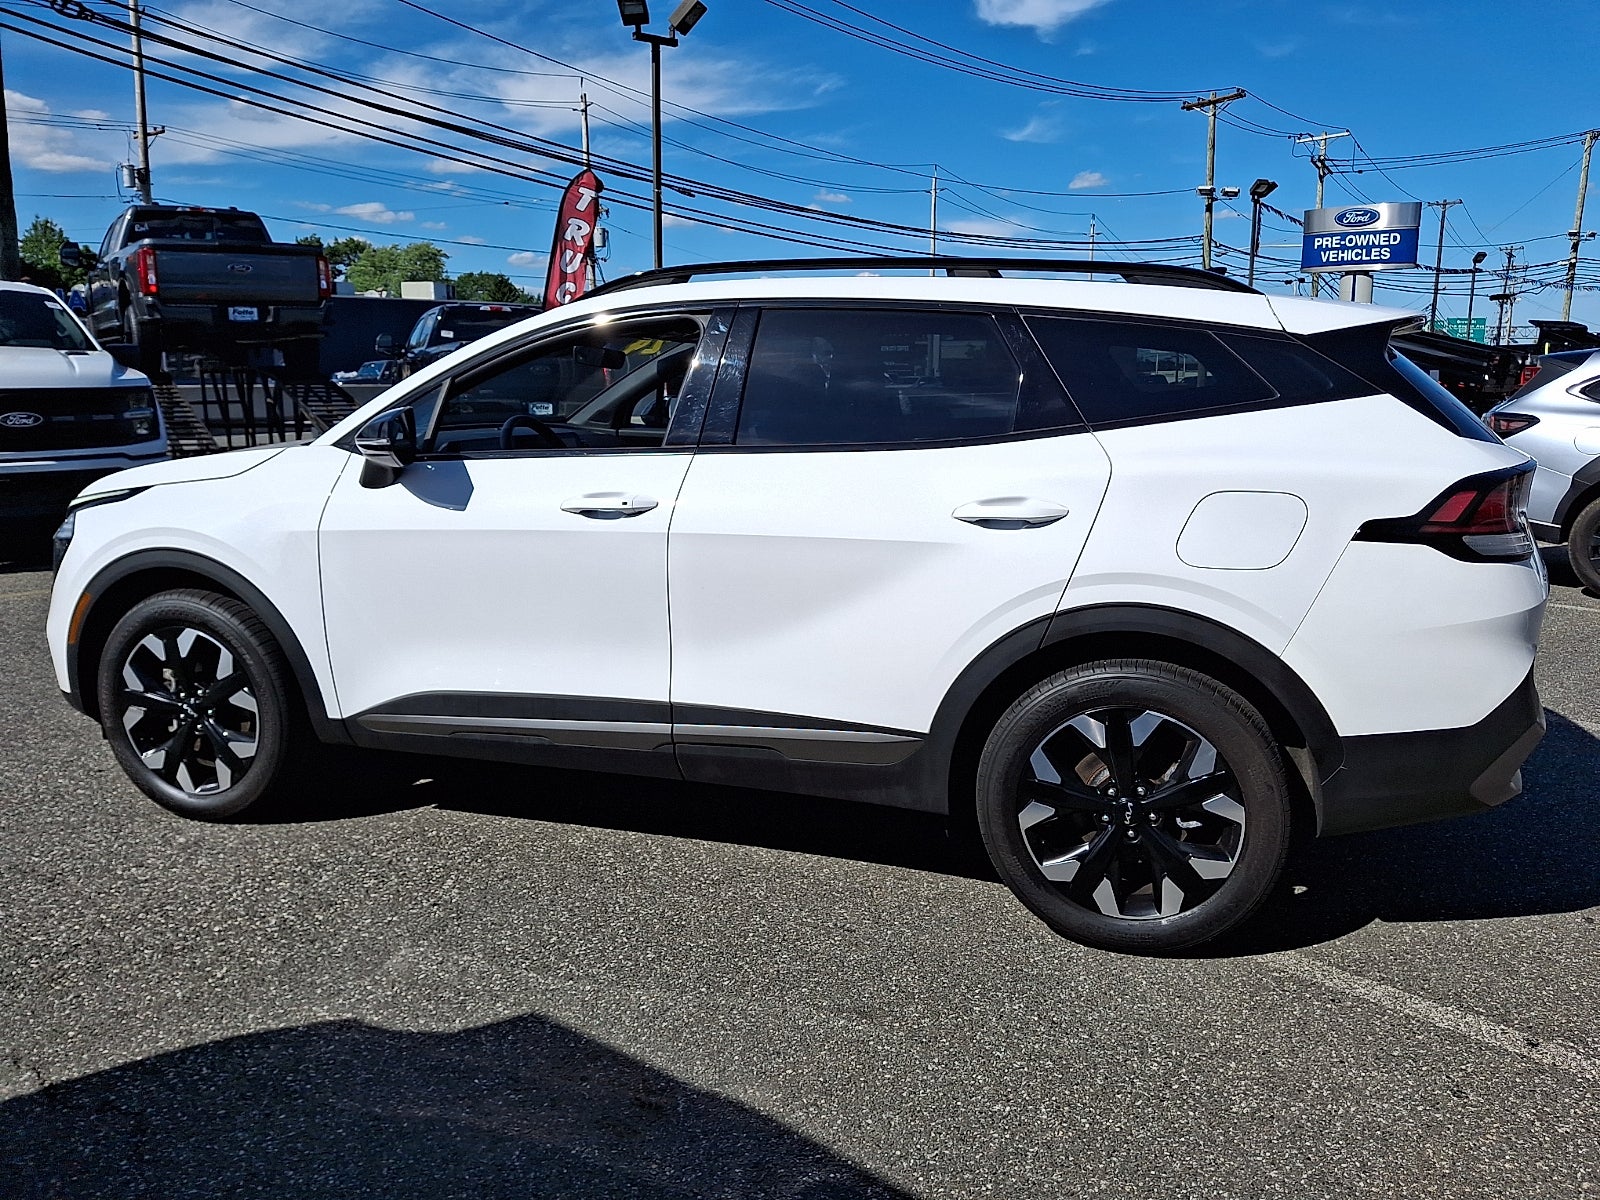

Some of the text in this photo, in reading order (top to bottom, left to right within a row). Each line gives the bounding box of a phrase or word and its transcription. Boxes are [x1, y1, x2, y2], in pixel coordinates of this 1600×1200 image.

[1342, 211, 1371, 224] Ford
[1314, 232, 1401, 249] PRE-OWNED
[1320, 247, 1391, 262] VEHICLES
[6, 414, 35, 425] Ford
